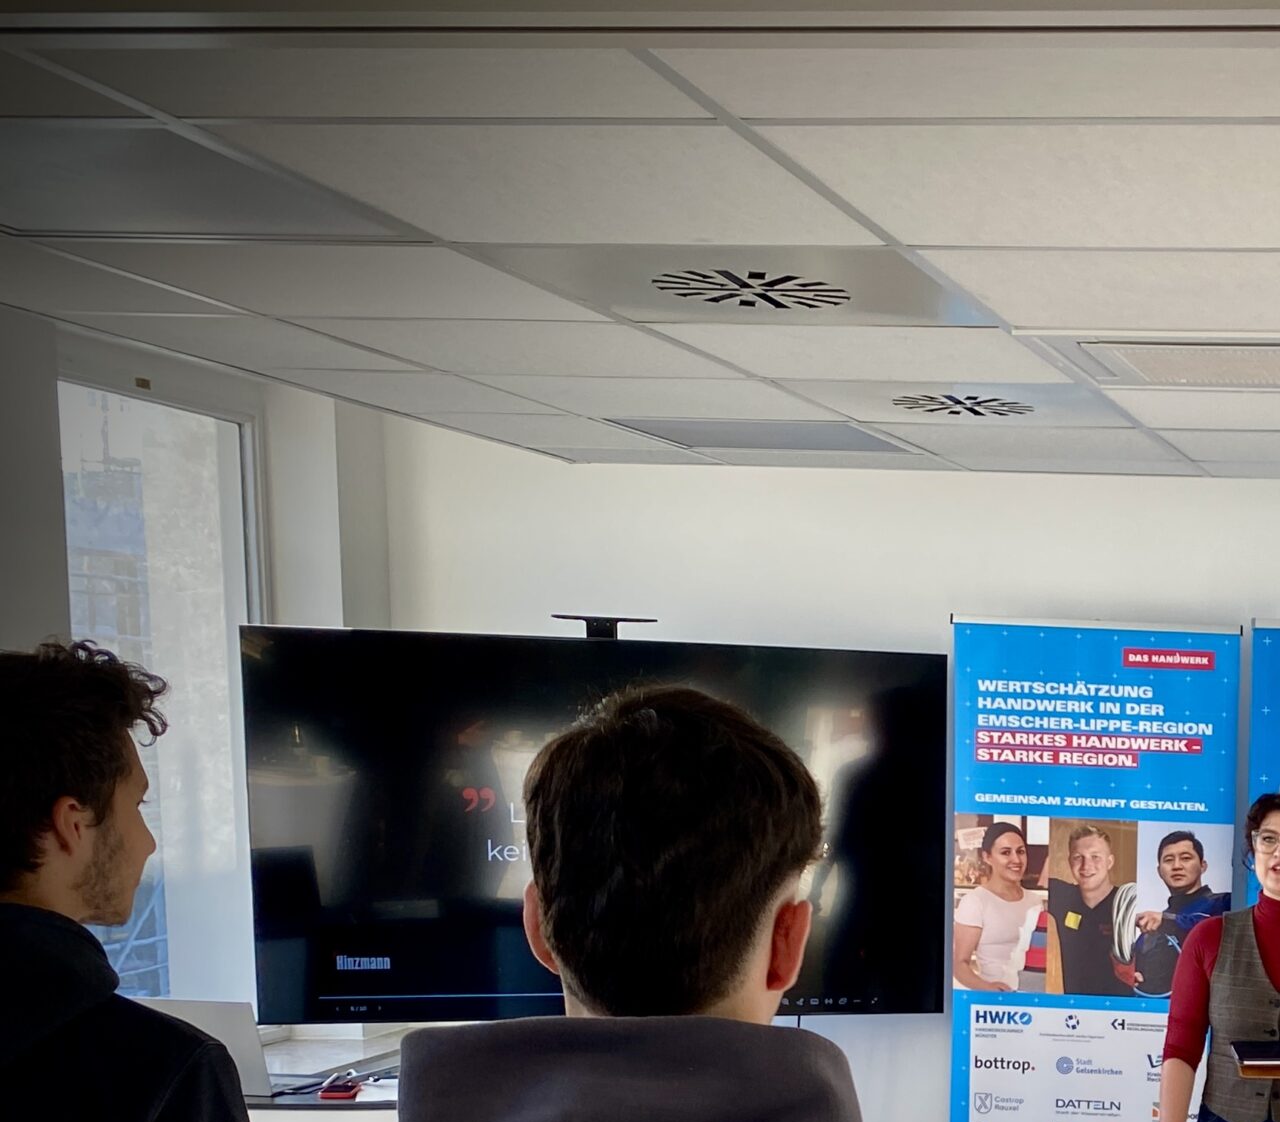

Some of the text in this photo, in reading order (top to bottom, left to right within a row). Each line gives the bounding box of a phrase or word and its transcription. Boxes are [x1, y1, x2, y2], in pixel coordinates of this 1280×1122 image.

[1129, 652, 1209, 665] DAS HANDWERK
[978, 680, 1153, 698] WERTSCHÄTZUNG
[978, 697, 1164, 716] HANDWERK IN DER
[978, 714, 1214, 735] EMSCHER-LIPPE-REGION
[977, 732, 1067, 747] STARKES
[1072, 736, 1188, 752] HANDWERK
[977, 749, 1138, 767] STARKE REGION.
[974, 794, 1208, 812] GEMEINSAM ZUKUNFT GESTALTEN.
[488, 839, 526, 861] kei
[336, 955, 390, 970] Hinzmann
[976, 1010, 1019, 1024] HWK
[975, 1056, 1035, 1074] bottrop.
[1076, 1067, 1122, 1076] Gelsenkirchen
[1056, 1099, 1120, 1110] DATTELN
